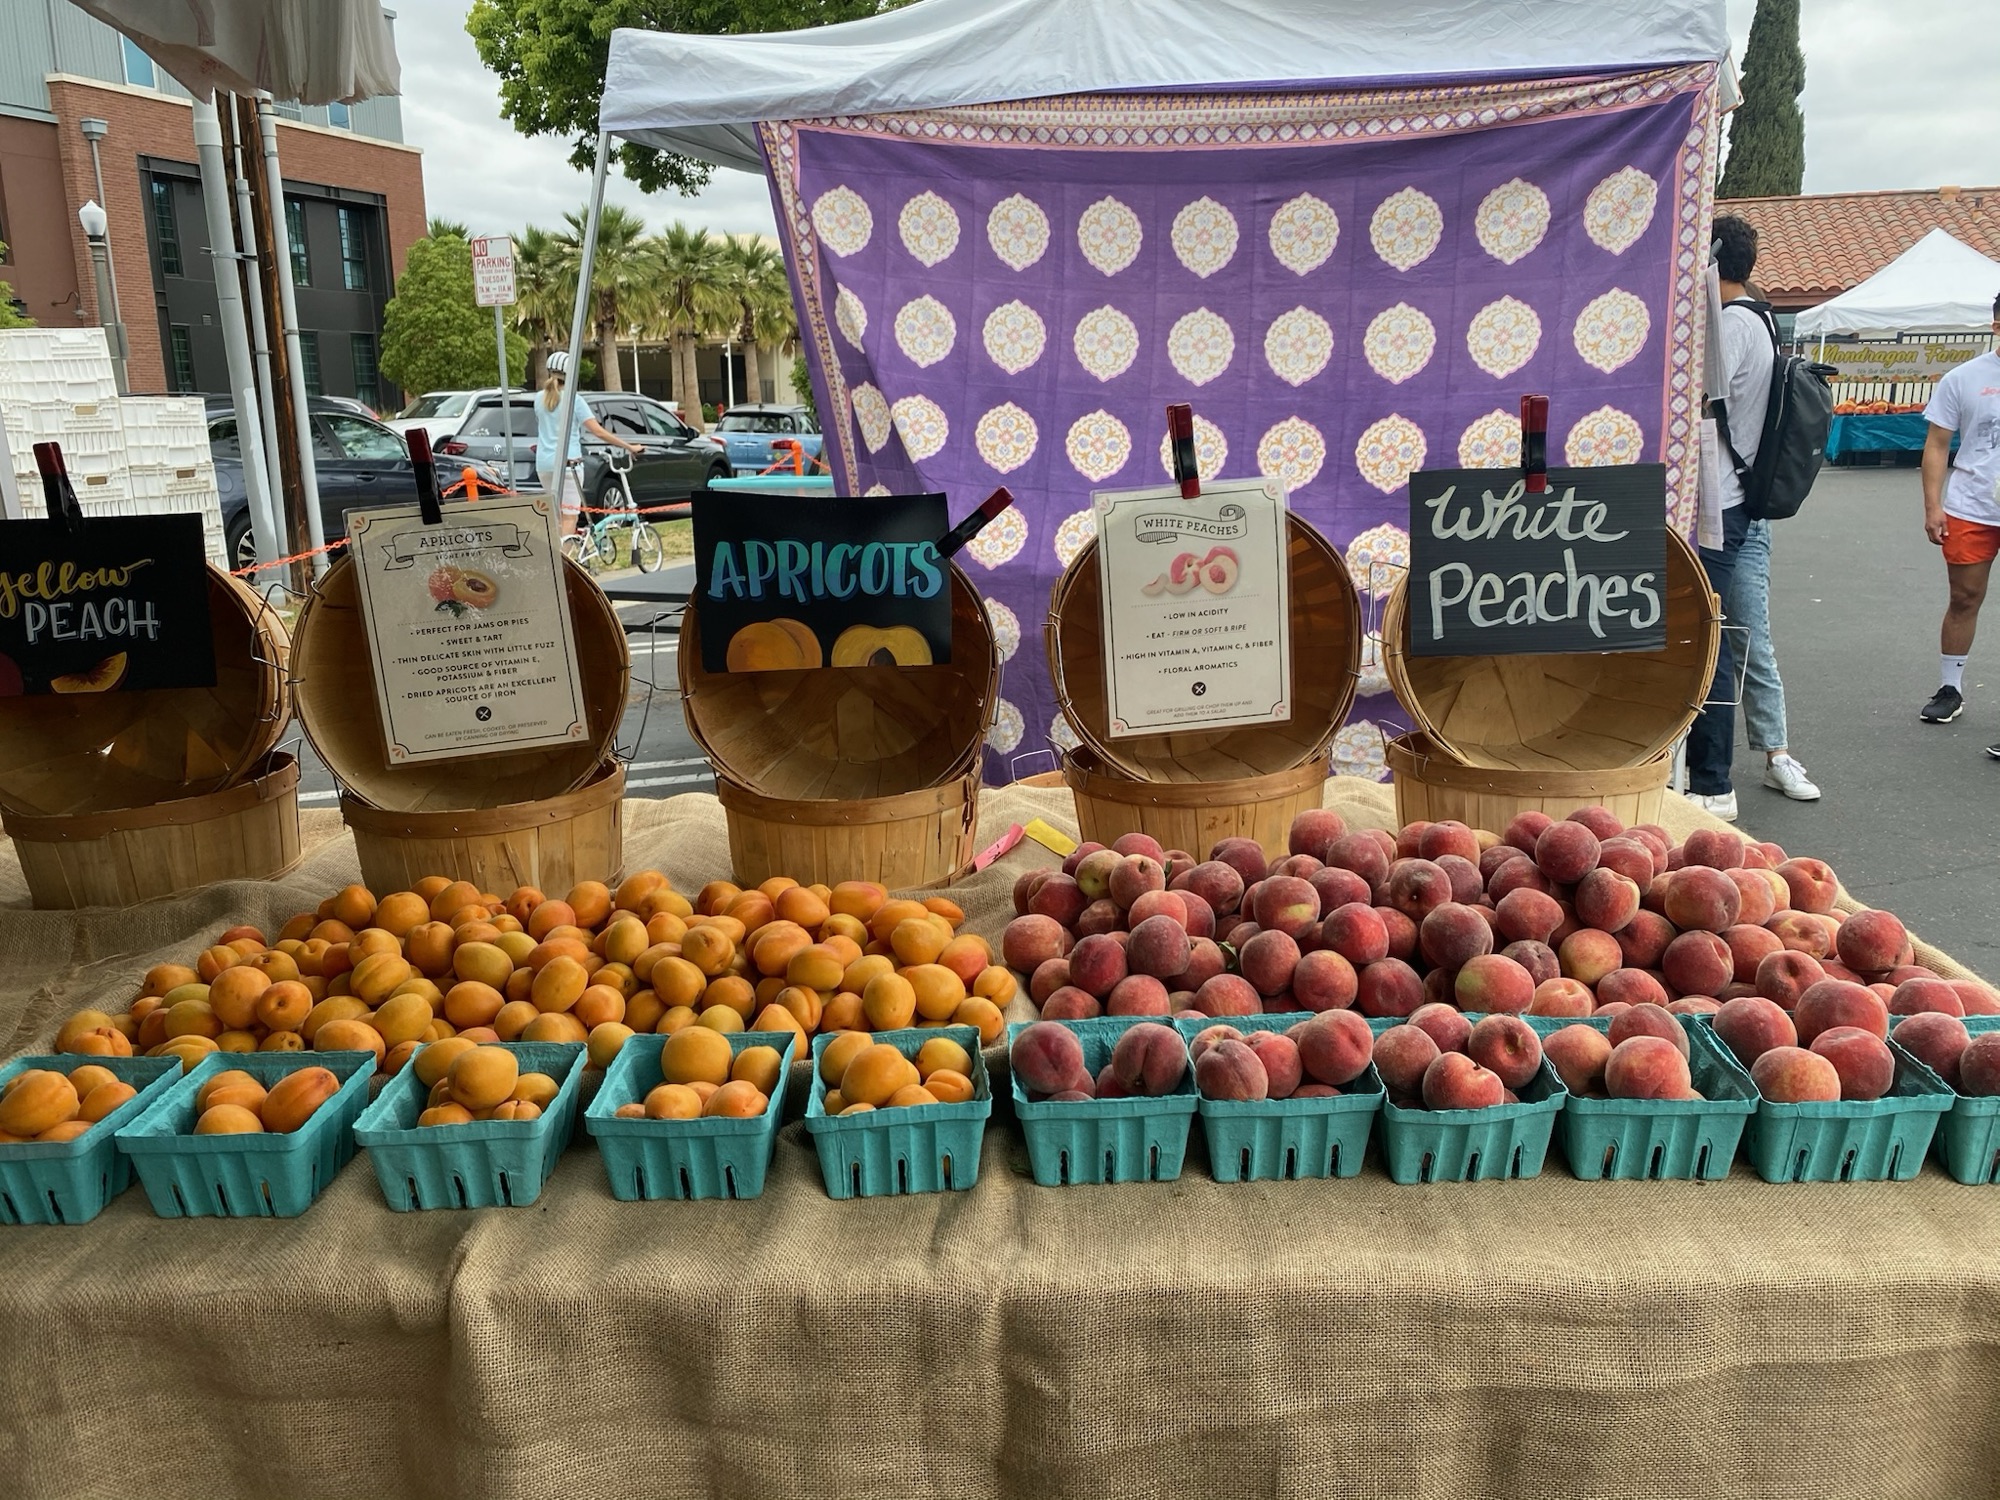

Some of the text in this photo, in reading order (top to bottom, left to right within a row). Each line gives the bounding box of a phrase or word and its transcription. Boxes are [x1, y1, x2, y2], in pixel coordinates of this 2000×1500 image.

[475, 240, 487, 256] NO
[477, 257, 510, 269] PARKING
[482, 275, 507, 283] TUESDAY
[1811, 344, 1918, 368] Mondragon
[1425, 479, 1630, 542] White
[1144, 519, 1239, 535] WHITE PEACHES
[420, 531, 493, 548] APRICOTS
[707, 541, 944, 604] APRICOTS
[1428, 548, 1661, 640] Peaches
[1198, 608, 1228, 616] ACIDITY
[25, 598, 161, 644] PEACH
[416, 626, 452, 636] PERFECT
[473, 622, 495, 630] JAMS
[511, 617, 529, 625] PIES
[1204, 626, 1222, 634] SOFT
[446, 637, 473, 646] SWEET
[483, 634, 503, 642] TART
[398, 641, 555, 664] THIN DELICATE SKIN WITH LITTLE FUZZ
[1158, 649, 1190, 657] VITAMIN
[1201, 644, 1233, 653] VITAMIN
[418, 667, 443, 676] GOOD
[445, 663, 479, 672] SOURCE
[495, 657, 530, 666] VITAMIN
[437, 672, 483, 682] POTASSIUM
[494, 667, 518, 676] FIBER
[1164, 662, 1238, 674] FLORAL AROMATICS
[408, 691, 434, 699] DRIED
[436, 686, 476, 696] APRICOTS
[512, 676, 556, 687] EXCELLENT
[445, 695, 479, 704] SOURCE
[518, 720, 548, 728] PRESERVED
